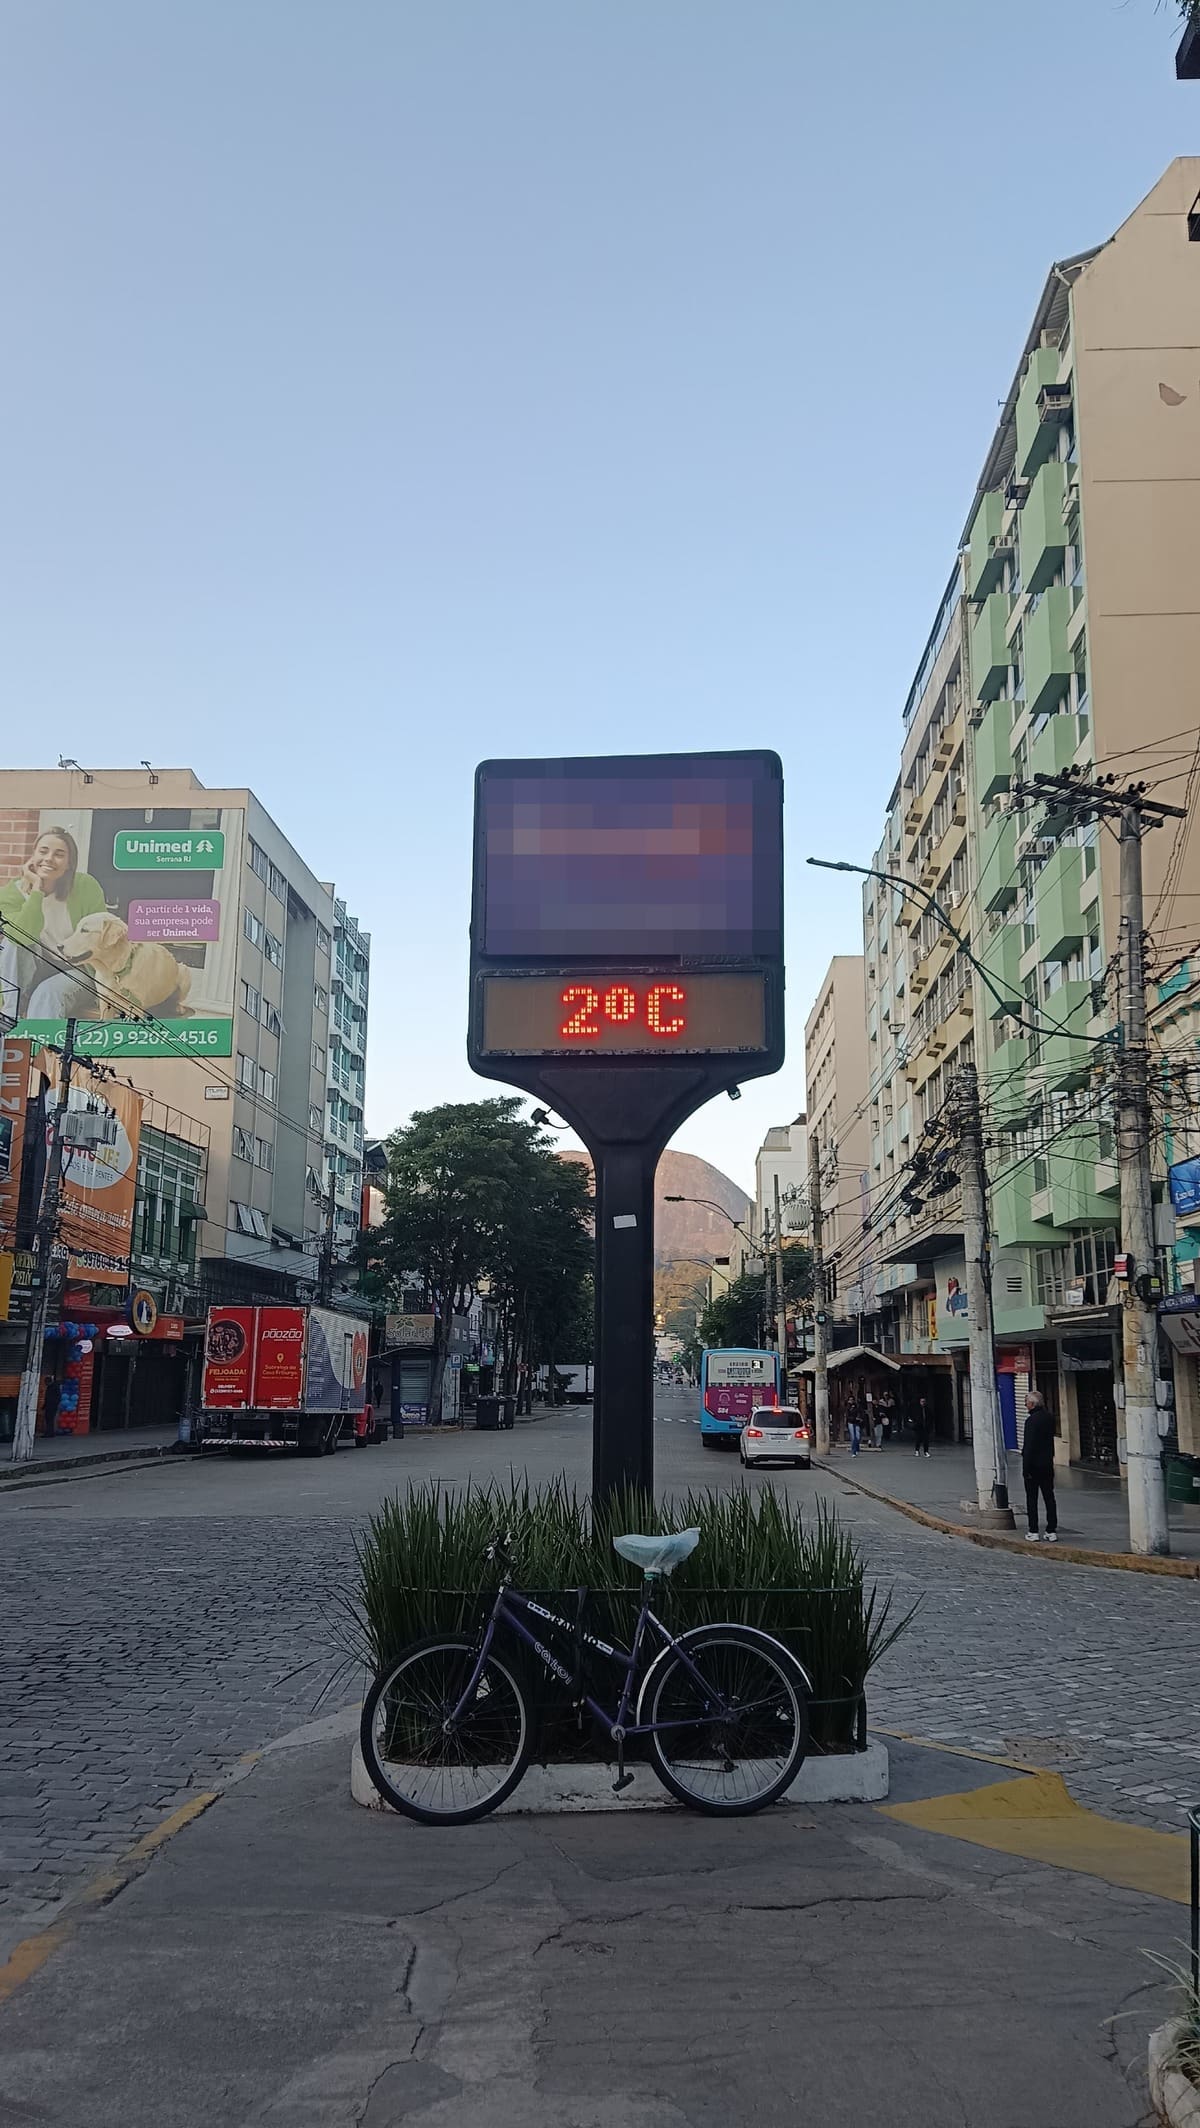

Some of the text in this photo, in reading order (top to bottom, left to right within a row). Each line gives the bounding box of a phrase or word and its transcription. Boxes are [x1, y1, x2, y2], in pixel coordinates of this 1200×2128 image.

[126, 840, 192, 853] Unimed
[135, 905, 213, 915] A partir de 1 vida,
[152, 919, 189, 927] empresa
[191, 917, 214, 927] pode
[162, 928, 199, 937] Unimed.
[77, 1030, 109, 1046] (22)
[113, 1031, 124, 1044] 9
[208, 1368, 247, 1376] FEIJOADA!
